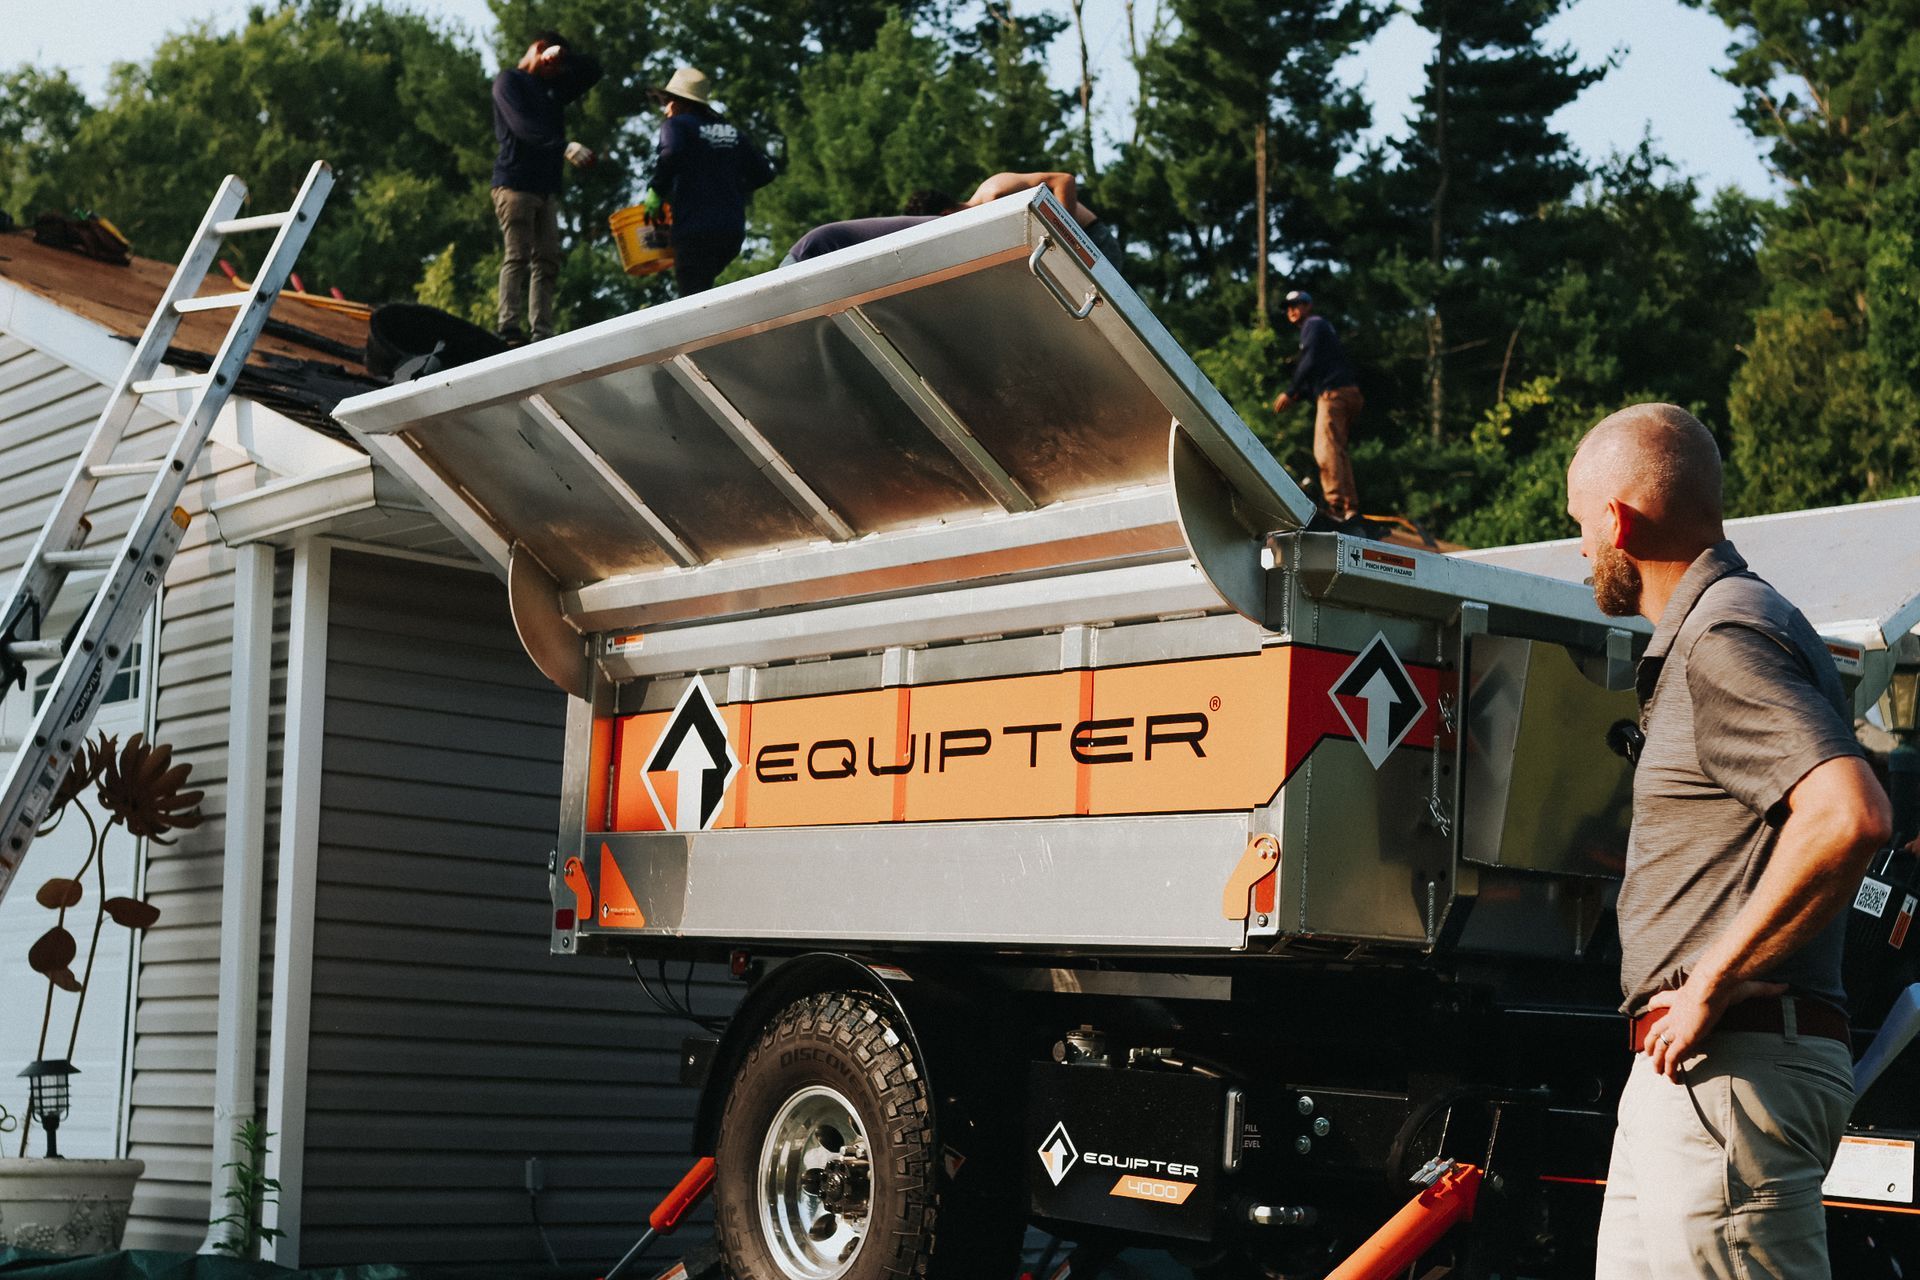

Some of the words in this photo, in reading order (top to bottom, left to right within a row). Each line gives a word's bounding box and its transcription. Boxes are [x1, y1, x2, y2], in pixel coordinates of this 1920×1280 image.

[1366, 562, 1379, 570] PINCH
[1380, 565, 1393, 573] POINT
[1393, 567, 1412, 576] HAZARD
[1244, 1123, 1258, 1132] FILL
[1242, 1139, 1261, 1148] EVEL
[1083, 1152, 1199, 1177] EQUIPTER
[1127, 1179, 1178, 1199] 4000
